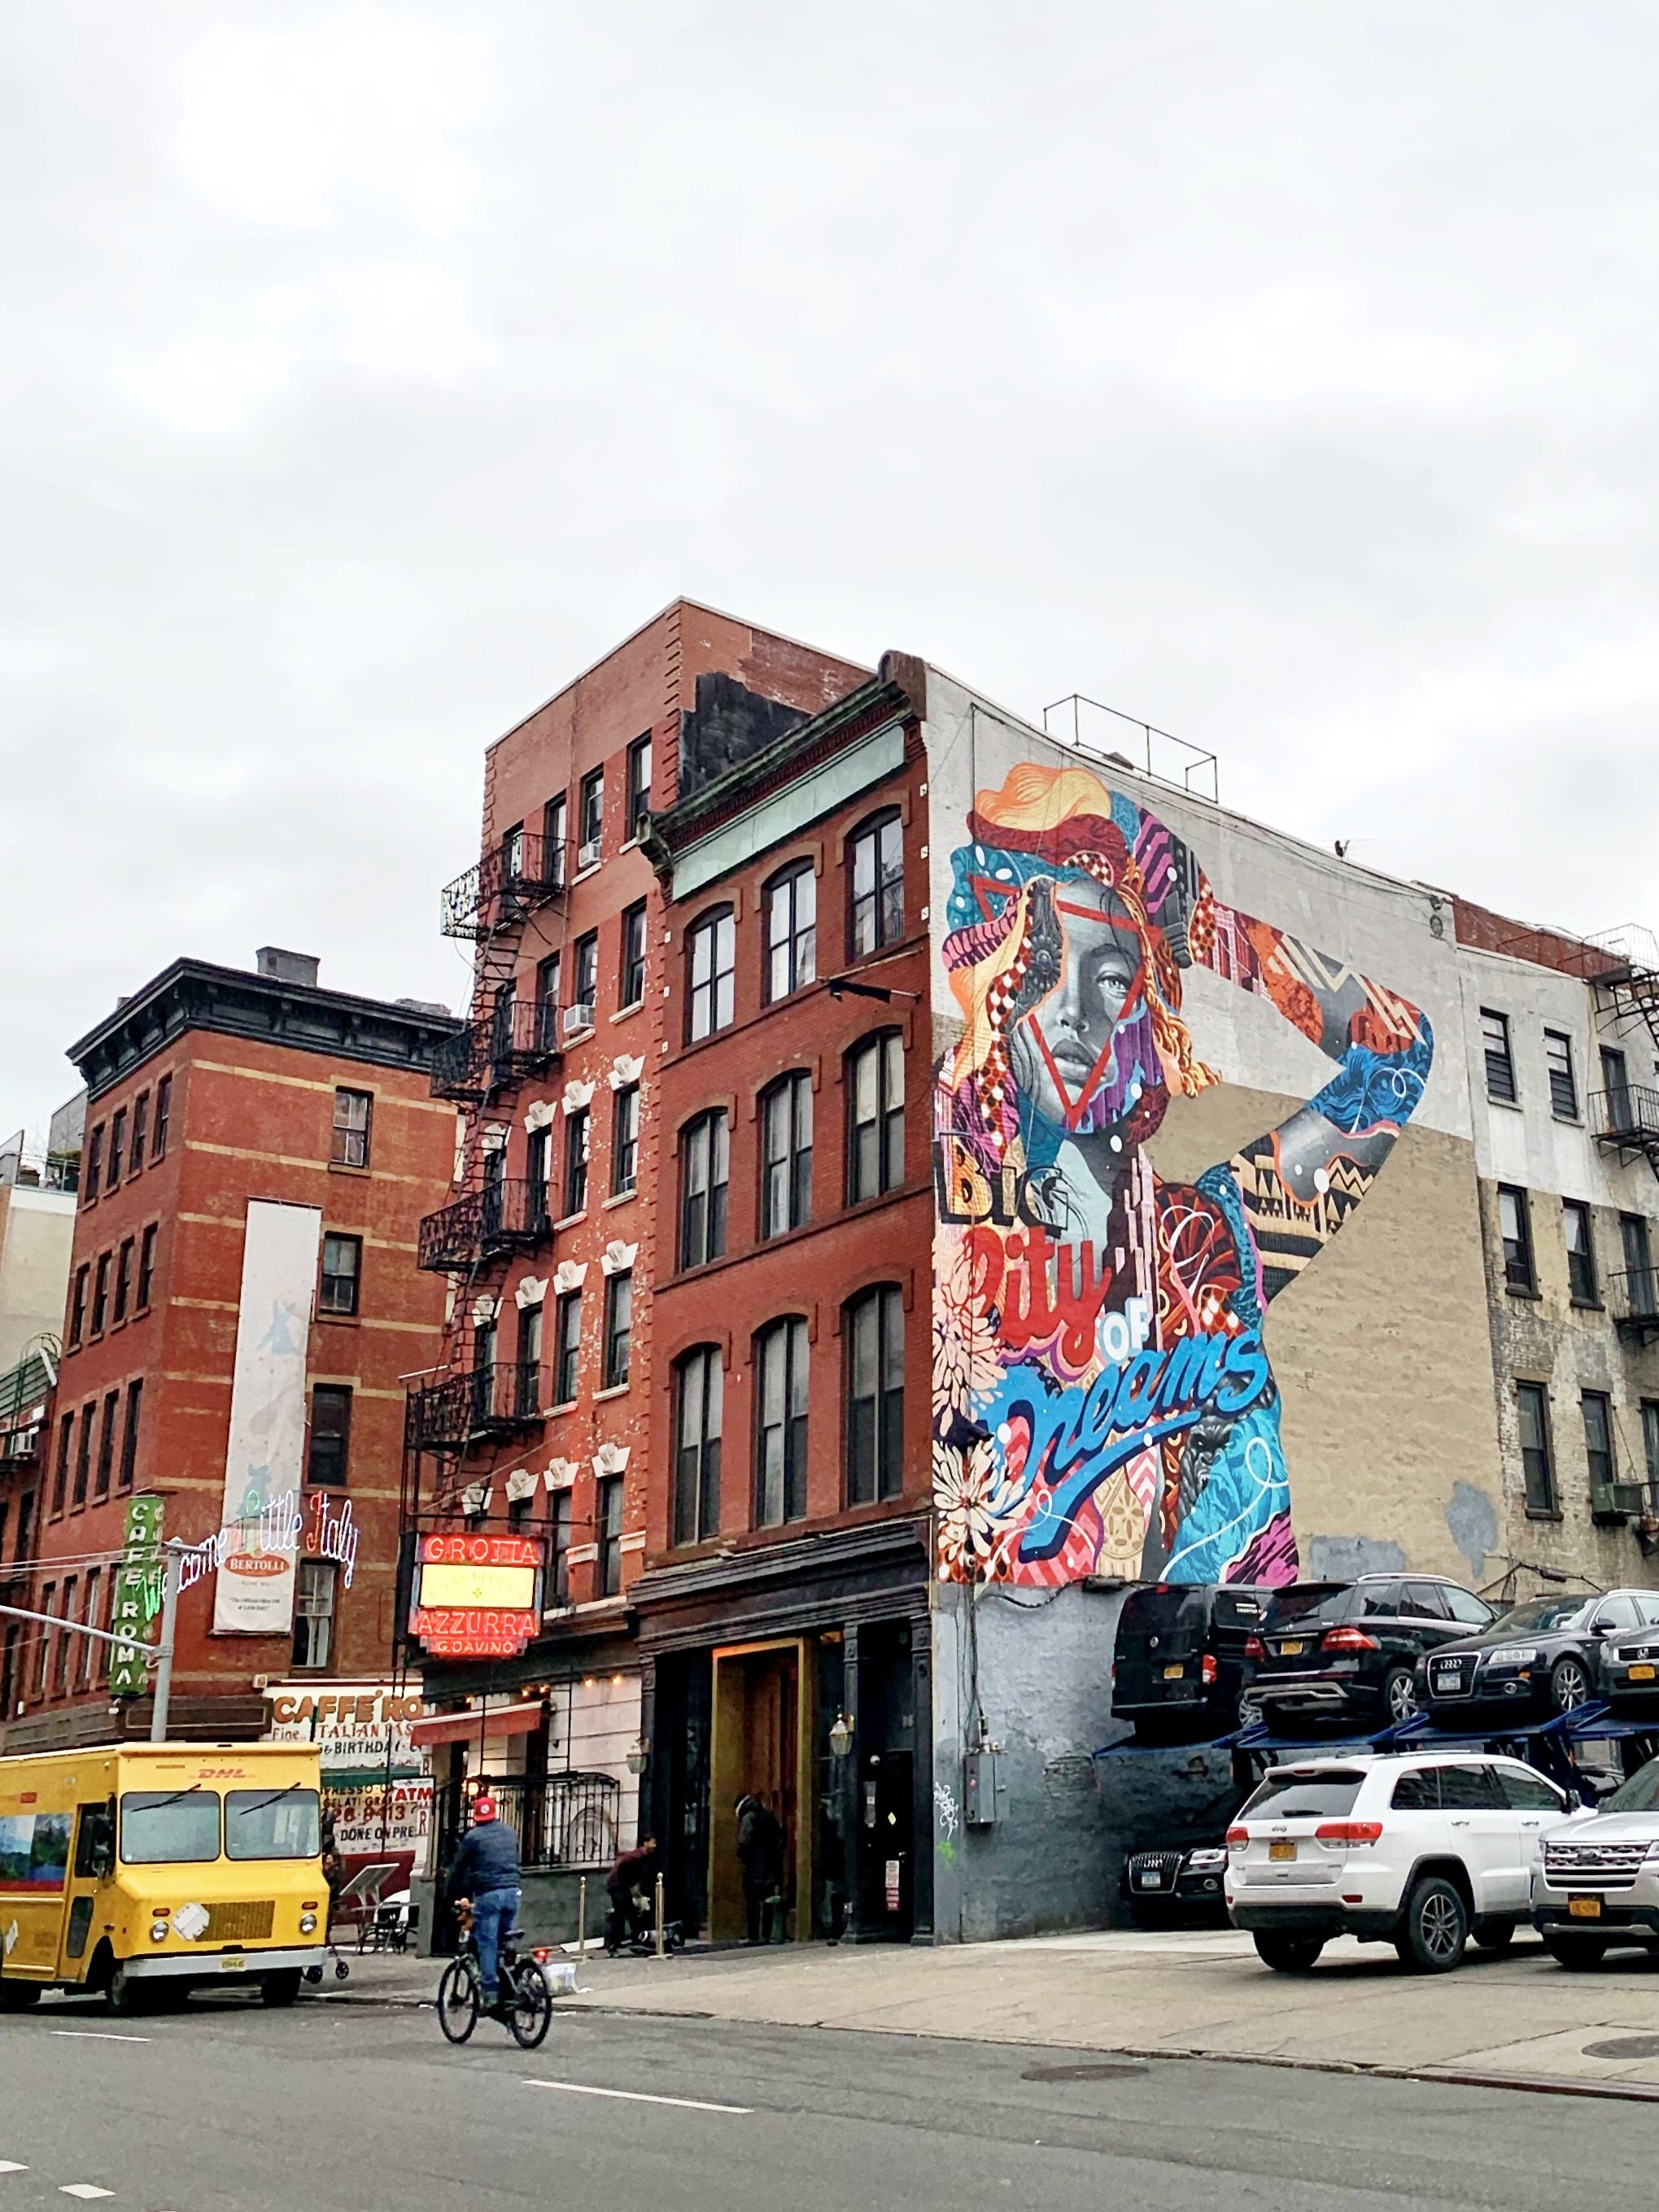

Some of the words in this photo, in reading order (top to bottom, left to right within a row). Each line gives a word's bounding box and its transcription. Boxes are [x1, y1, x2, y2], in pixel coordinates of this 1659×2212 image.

[126, 1503, 148, 1586] CAFE
[307, 1489, 359, 1589] Italy
[429, 1537, 539, 1564] GROTTA
[229, 1558, 285, 1571] BERTOLLI
[415, 1611, 538, 1635] AZZURRA
[117, 1601, 138, 1685] ROMA
[319, 1722, 380, 1739] TALIAN
[199, 1769, 246, 1778] DHL
[395, 1787, 433, 1801] ATM
[341, 1826, 372, 1841] DONE
